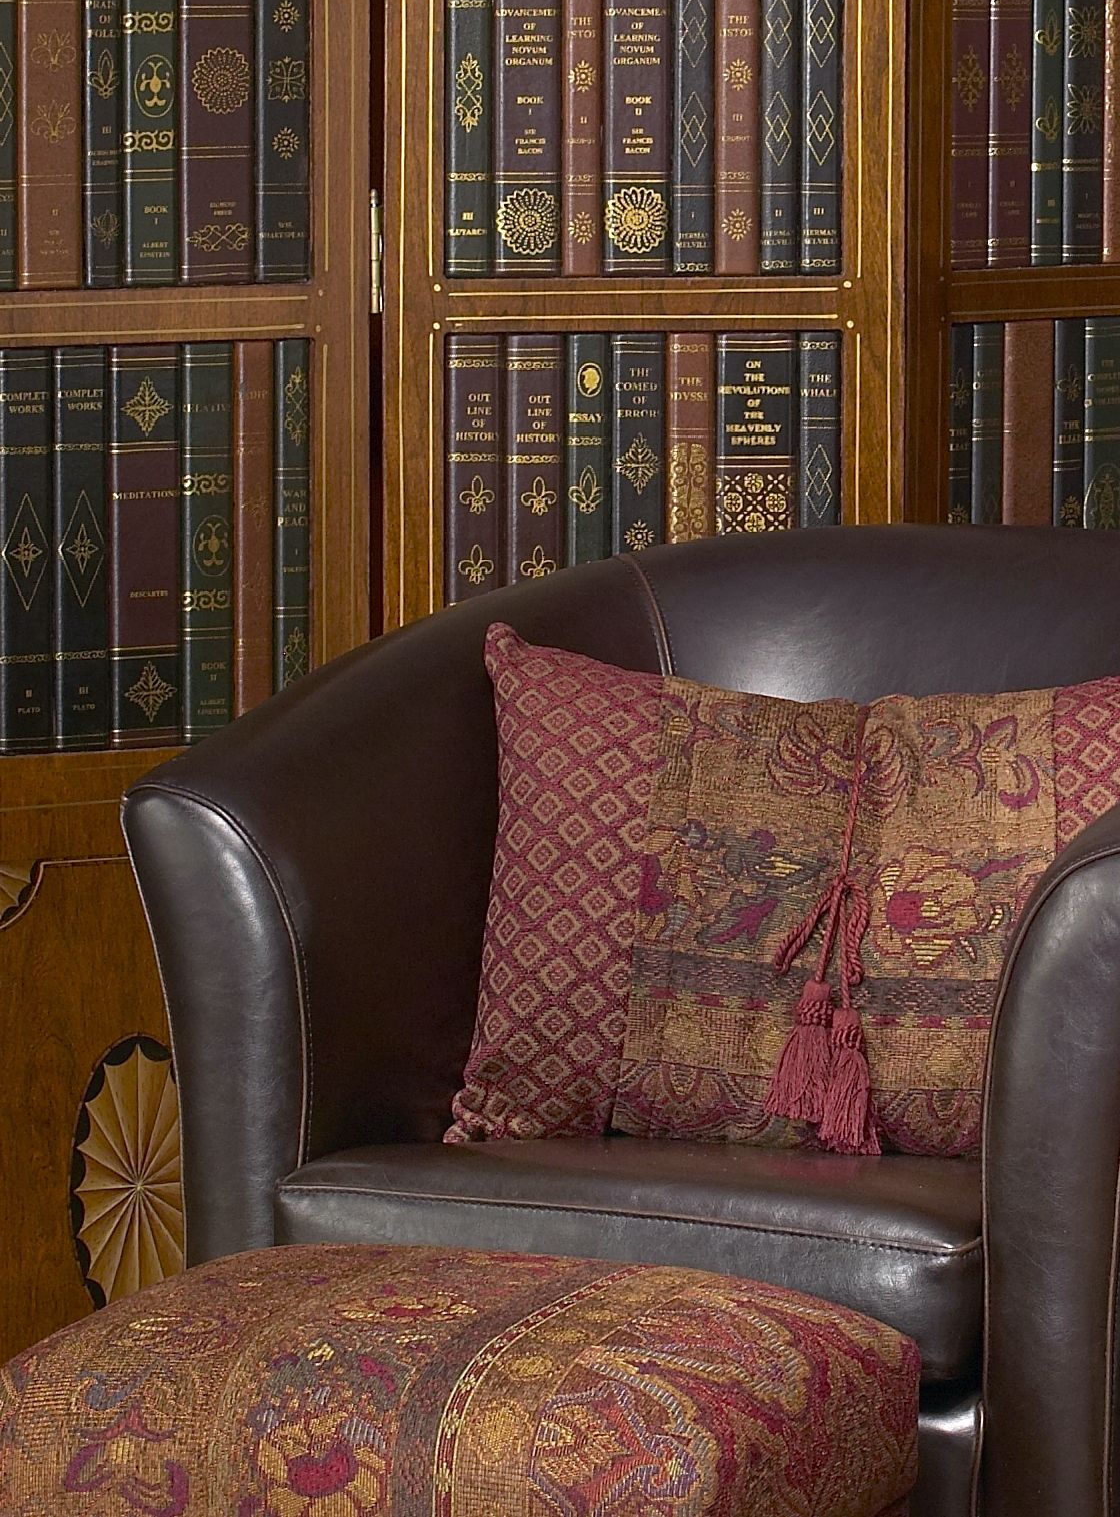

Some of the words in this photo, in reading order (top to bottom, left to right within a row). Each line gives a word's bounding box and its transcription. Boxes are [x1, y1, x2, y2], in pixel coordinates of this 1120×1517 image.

[524, 22, 536, 30] OF
[506, 34, 553, 42] LEARNING
[614, 34, 660, 42] LEARNING
[512, 46, 546, 54] NOVUM
[620, 45, 654, 53] NOVUM
[613, 57, 660, 65] ORGANUM
[626, 96, 651, 104] BOOK
[144, 206, 168, 214] BOOK
[746, 361, 761, 369] ON
[679, 377, 702, 386] THE
[809, 374, 831, 382] THE
[469, 394, 491, 402] OUT
[529, 396, 551, 404] OUT
[68, 402, 102, 410] WORKS
[747, 399, 761, 407] OF
[10, 404, 44, 414] WORKS
[467, 407, 491, 415] LINE
[528, 409, 552, 417] LINE
[744, 411, 764, 419] THE
[472, 419, 485, 428] OF
